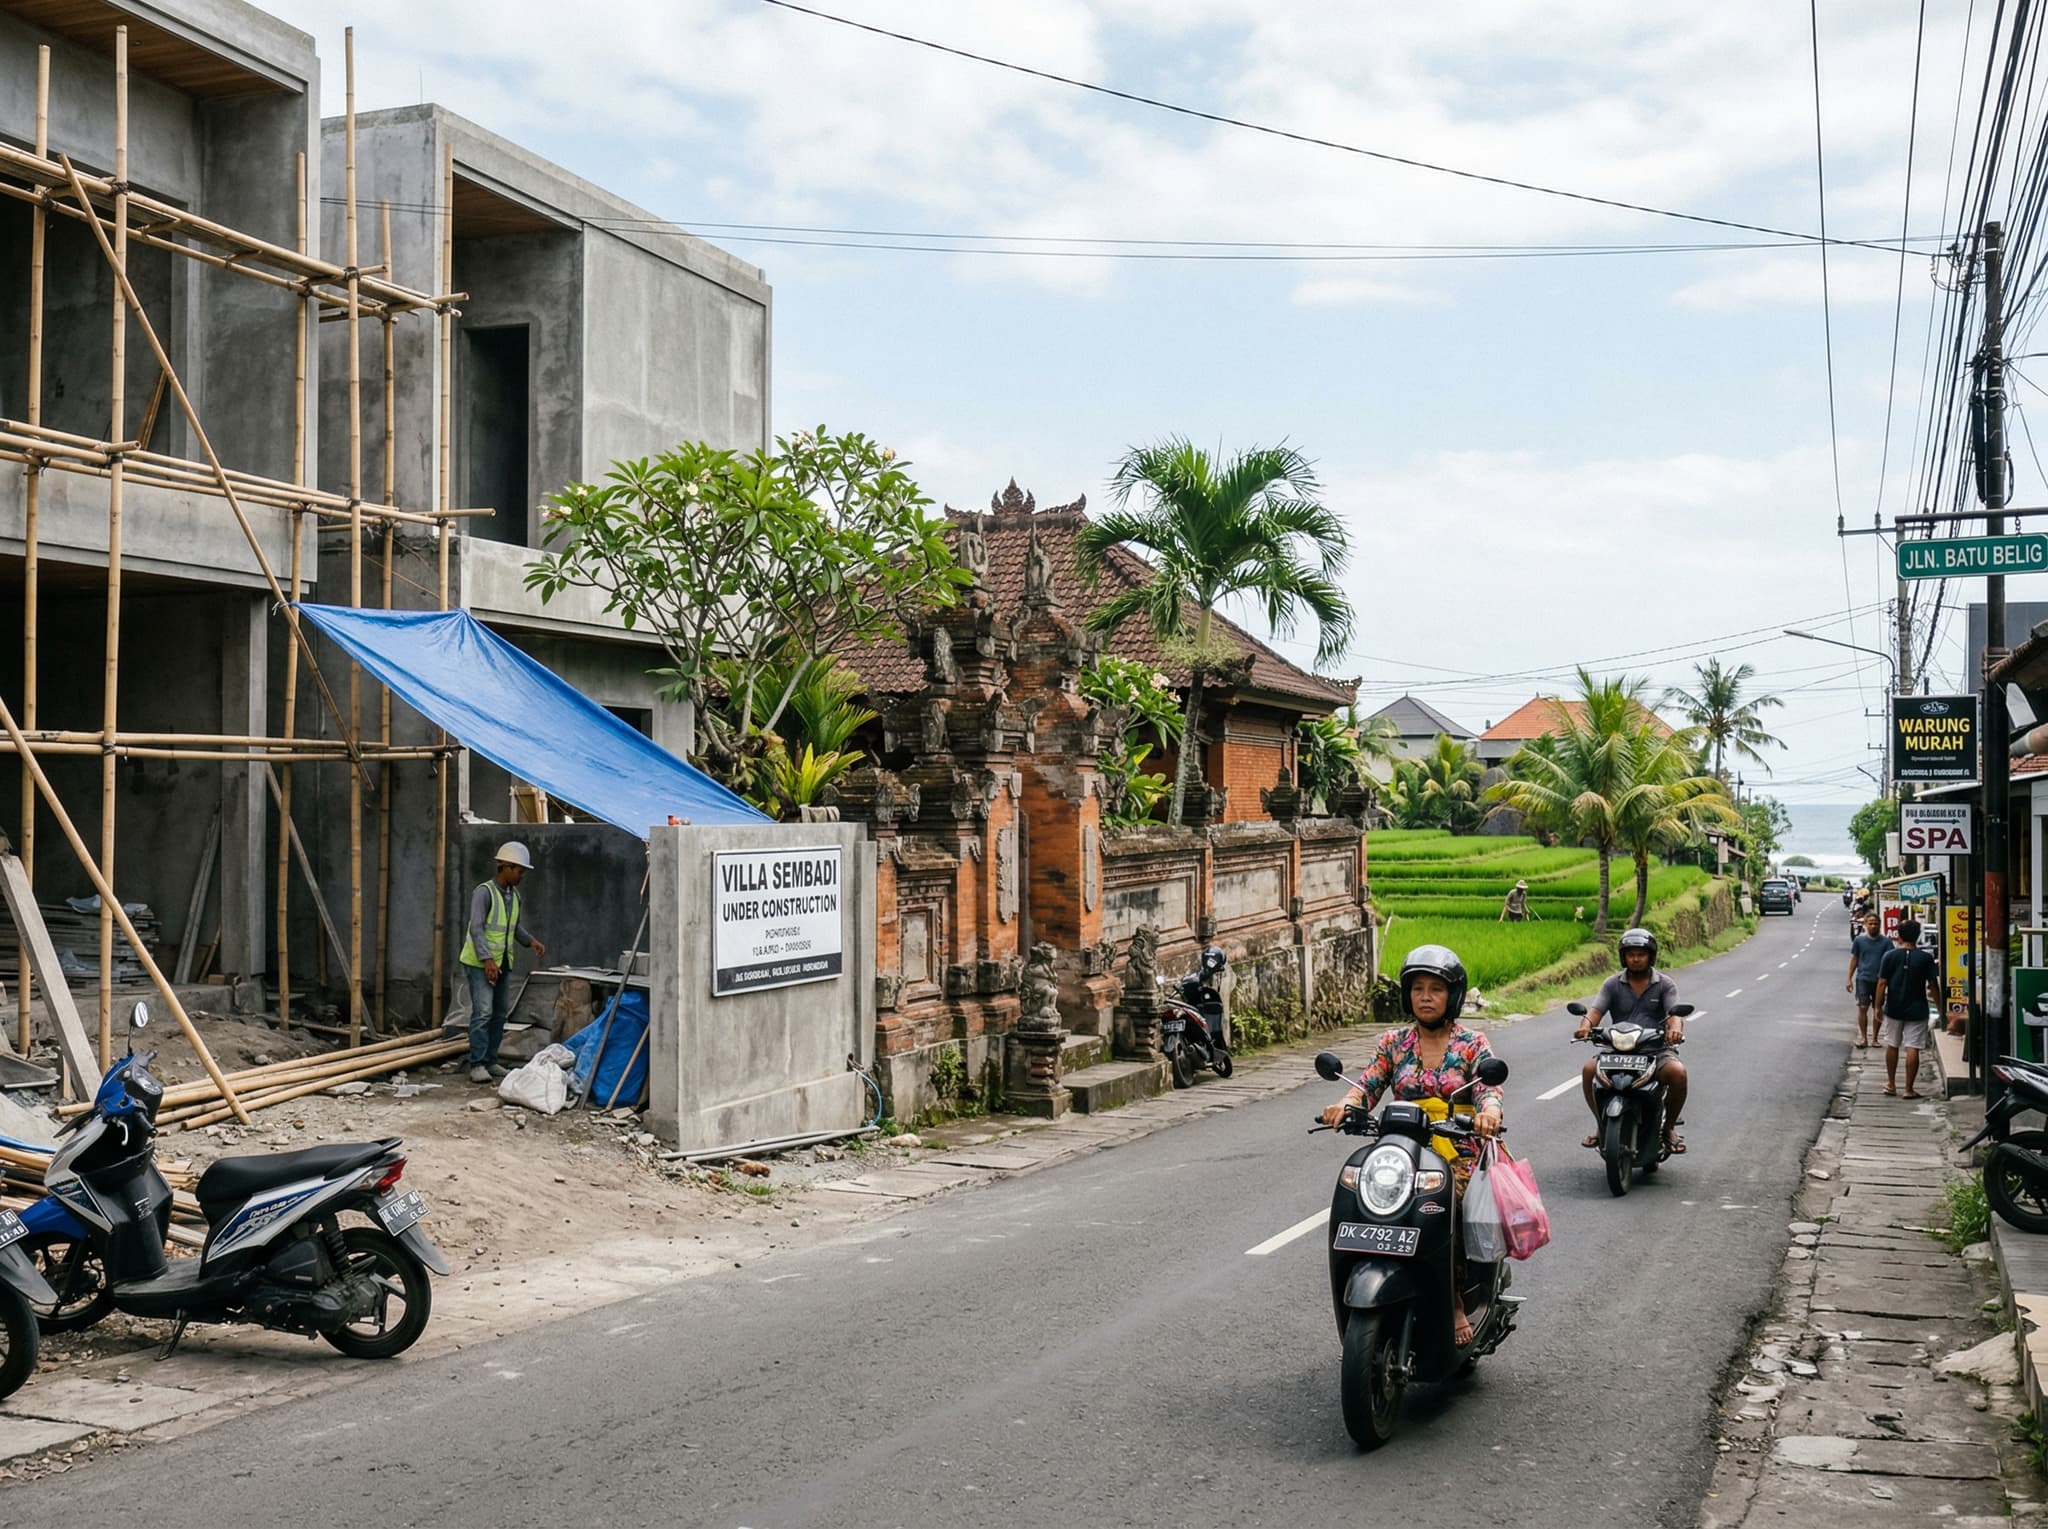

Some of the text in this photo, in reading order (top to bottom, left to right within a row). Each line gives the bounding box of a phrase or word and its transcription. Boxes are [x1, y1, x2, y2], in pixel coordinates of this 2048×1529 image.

[1905, 543, 2043, 570] JLN. BATU BELIG
[1898, 718, 1970, 734] WARUNG
[1905, 736, 1964, 751] MURAH
[1906, 827, 1968, 849] SPA
[722, 859, 837, 892] VILLA SEMBADI
[722, 894, 837, 922] UNDER CONSTRUCTION
[1339, 1225, 1357, 1238] DK
[1397, 1230, 1416, 1244] AZ
